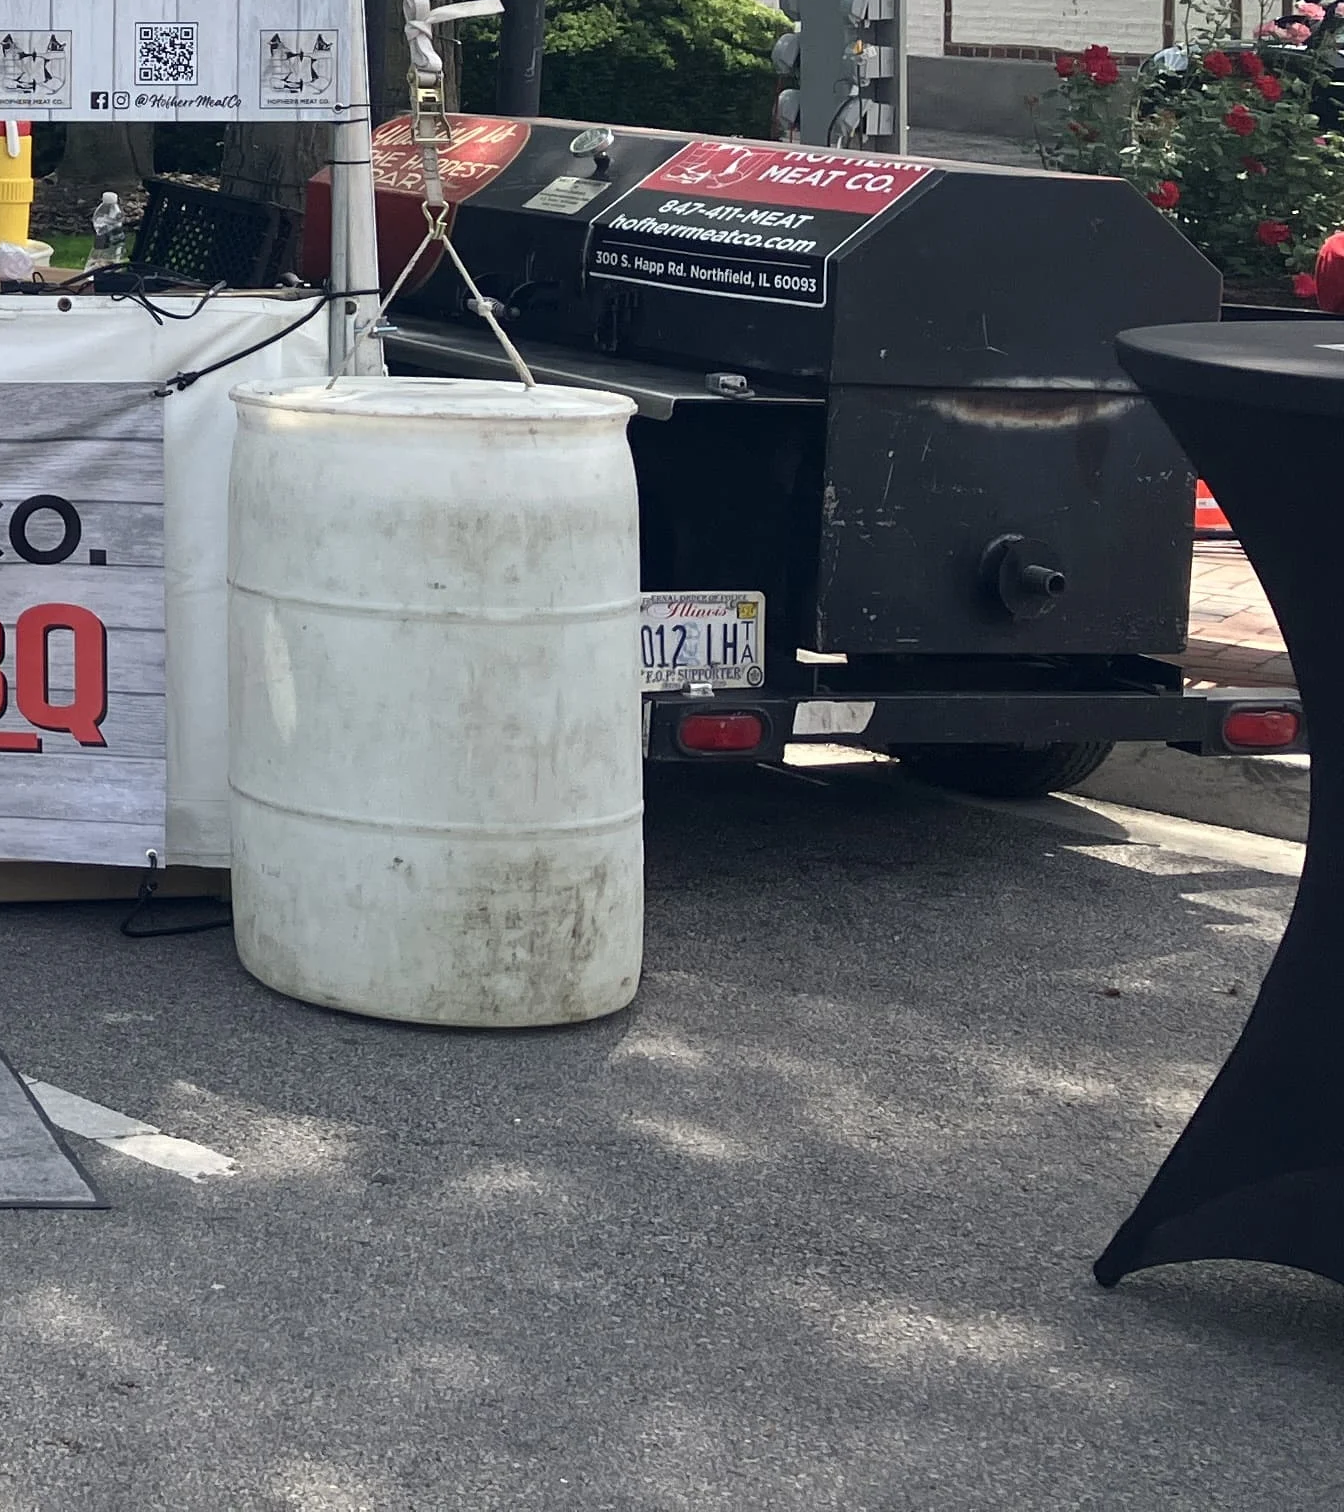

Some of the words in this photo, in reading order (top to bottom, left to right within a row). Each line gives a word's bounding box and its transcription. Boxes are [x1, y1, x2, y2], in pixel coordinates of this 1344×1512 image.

[758, 165, 848, 188] MEAT
[845, 172, 895, 193] CO.
[658, 199, 814, 230] 847-411-MEAT
[609, 213, 817, 254] hofherrmeatco.com
[595, 251, 619, 266] 300
[620, 254, 632, 269] S.
[634, 257, 665, 276] Happ
[667, 261, 688, 278] Rd.
[690, 266, 755, 289] Northfield,
[758, 272, 771, 288] IL
[774, 276, 817, 293] 60093
[666, 601, 728, 619] Illinois
[677, 668, 743, 681] SUPPORTER
